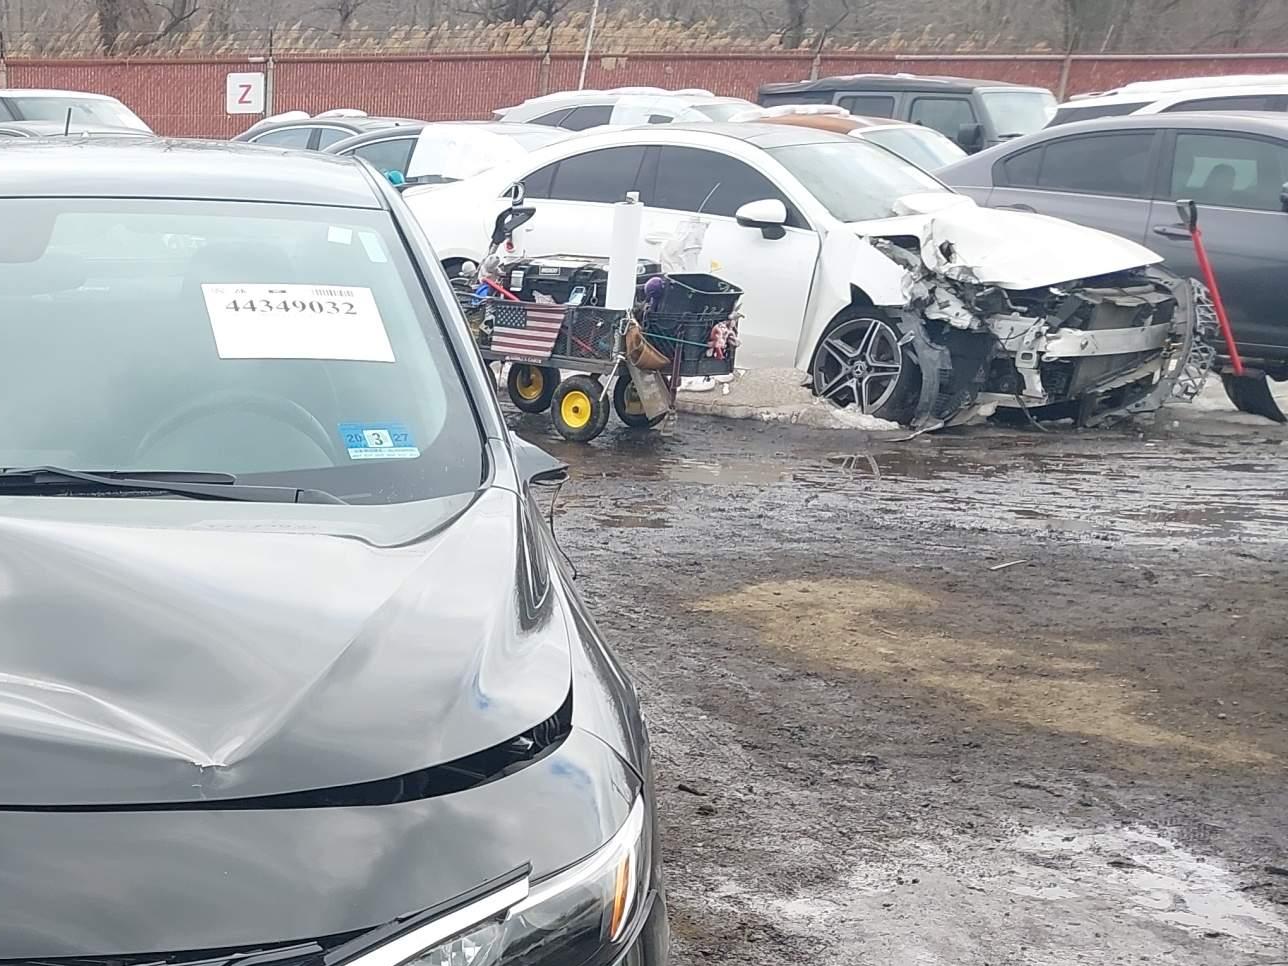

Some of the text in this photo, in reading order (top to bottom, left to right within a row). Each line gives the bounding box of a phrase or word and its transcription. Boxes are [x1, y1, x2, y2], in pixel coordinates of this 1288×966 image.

[238, 84, 253, 104] Z
[225, 299, 358, 315] 44349032
[371, 432, 384, 445] 3
[392, 433, 409, 442] 27
